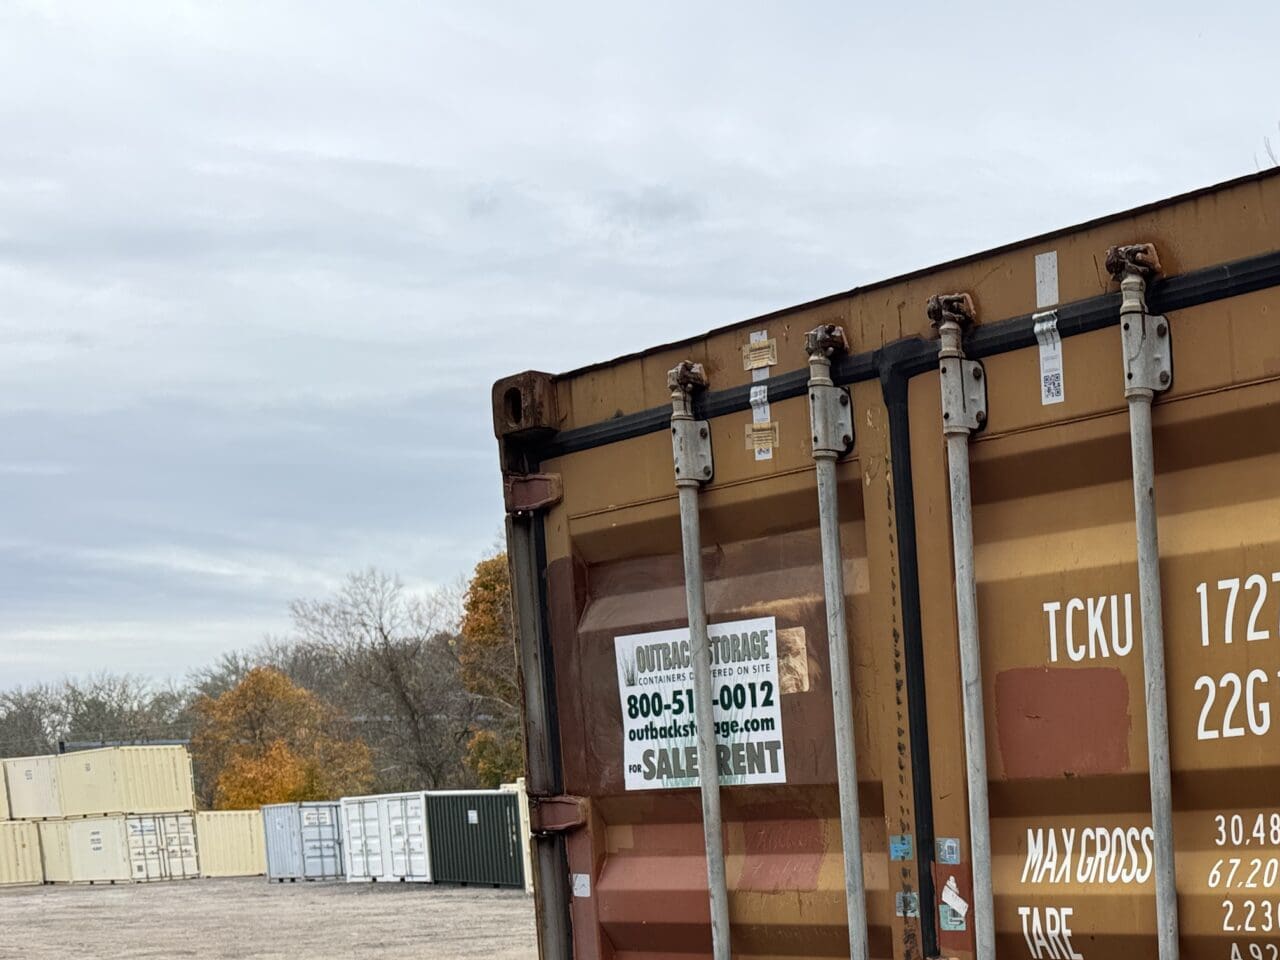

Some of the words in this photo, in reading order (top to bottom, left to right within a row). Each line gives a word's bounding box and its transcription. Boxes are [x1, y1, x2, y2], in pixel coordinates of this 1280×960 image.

[1043, 593, 1133, 662] TCKU
[635, 640, 692, 674] OUTBAC
[638, 675, 686, 686] CONTAINERS
[737, 667, 749, 676] ON
[752, 664, 771, 673] SITE
[627, 681, 774, 719] 800-51-0012
[629, 717, 775, 742] outbackstage.com
[628, 764, 642, 774] FOR
[642, 746, 699, 781] SALE
[716, 740, 781, 777] RENT
[1020, 827, 1076, 884] MAX
[1076, 826, 1155, 884] GROSS
[1018, 906, 1084, 960] TARE
